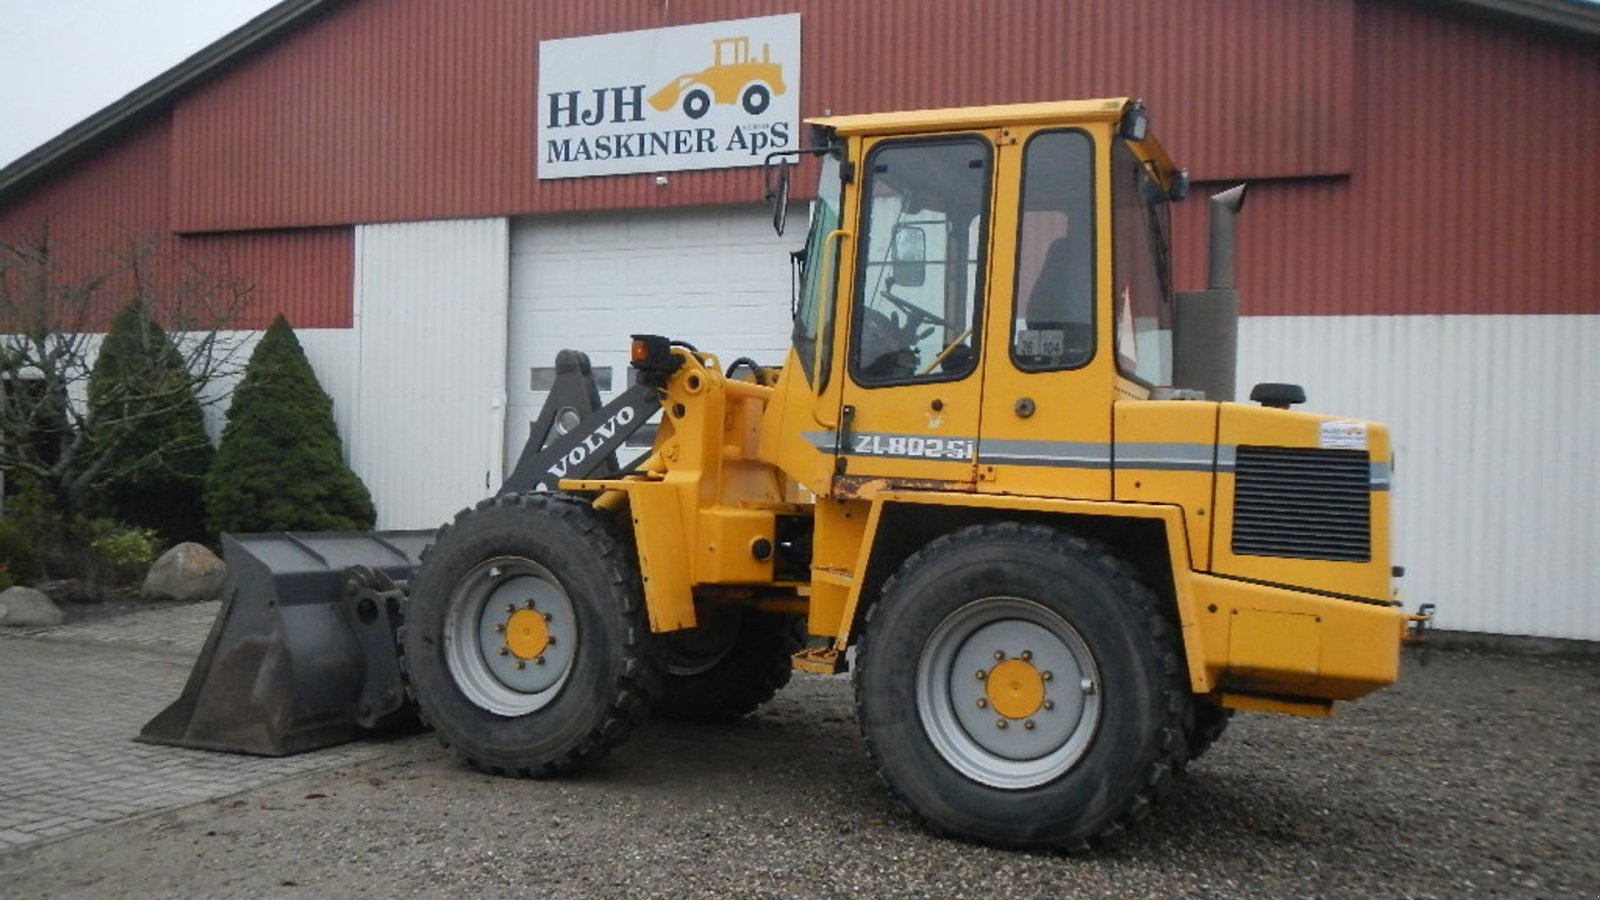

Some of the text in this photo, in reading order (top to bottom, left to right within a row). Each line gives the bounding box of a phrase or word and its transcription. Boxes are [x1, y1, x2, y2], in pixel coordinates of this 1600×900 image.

[547, 84, 647, 128] HJH
[546, 121, 790, 163] MASKINER ApS
[547, 406, 634, 478] VOLVO
